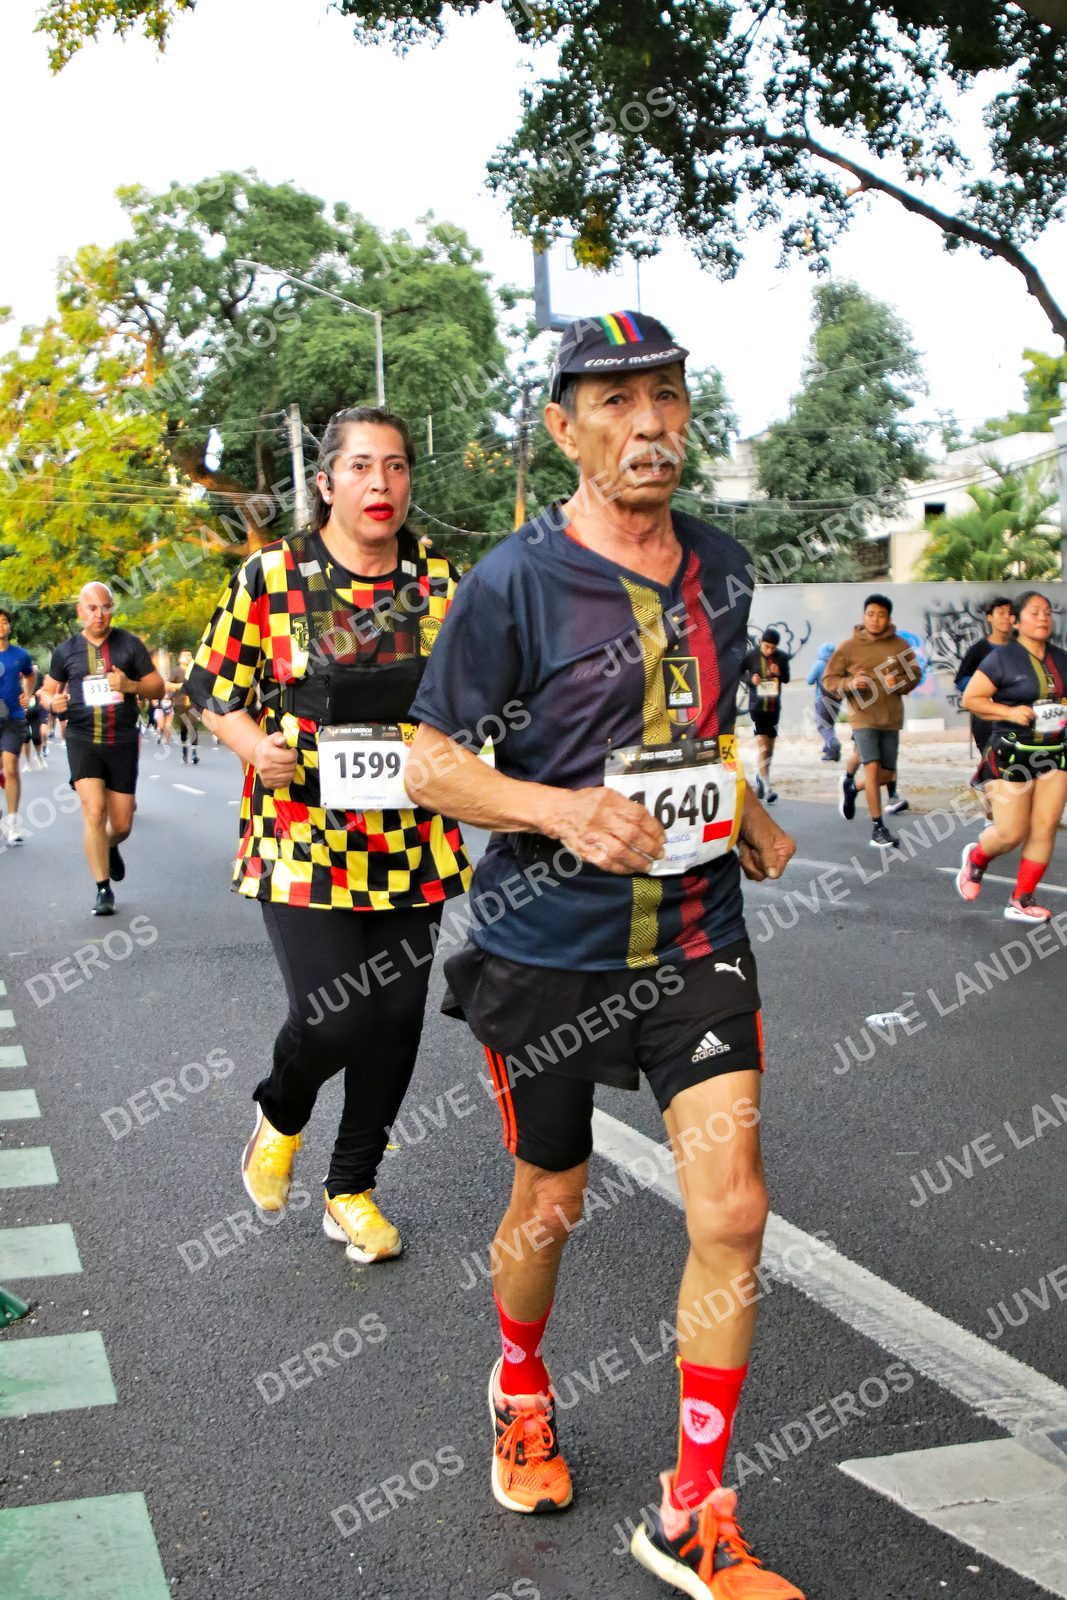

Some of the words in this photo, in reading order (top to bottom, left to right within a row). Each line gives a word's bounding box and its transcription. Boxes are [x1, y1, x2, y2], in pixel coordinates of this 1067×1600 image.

[584, 358, 625, 368] EDDY
[334, 751, 401, 779] 1599
[691, 1043, 731, 1063] adidas
